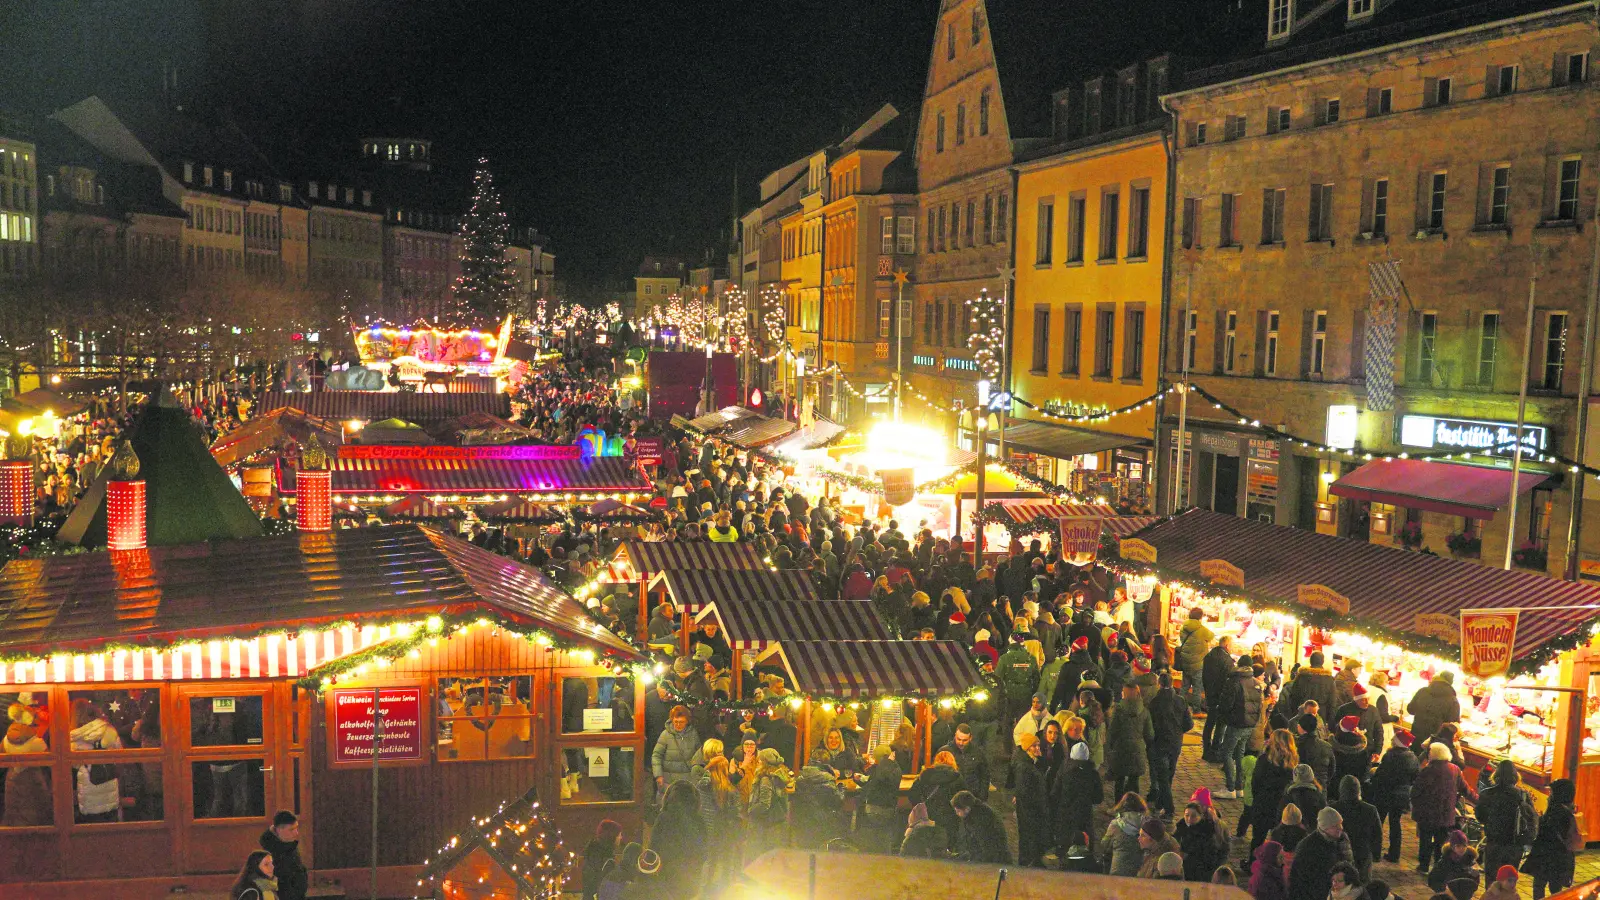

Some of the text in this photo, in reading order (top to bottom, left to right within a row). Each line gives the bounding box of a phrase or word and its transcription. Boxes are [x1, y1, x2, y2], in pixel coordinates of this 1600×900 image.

[1466, 624, 1512, 644] Mandeln
[338, 695, 372, 706] Glühwein
[340, 719, 416, 730] alkoholfr Getränke
[346, 731, 411, 741] Feuerzaenbowle
[344, 746, 413, 756] Kaffeespzialitäten
